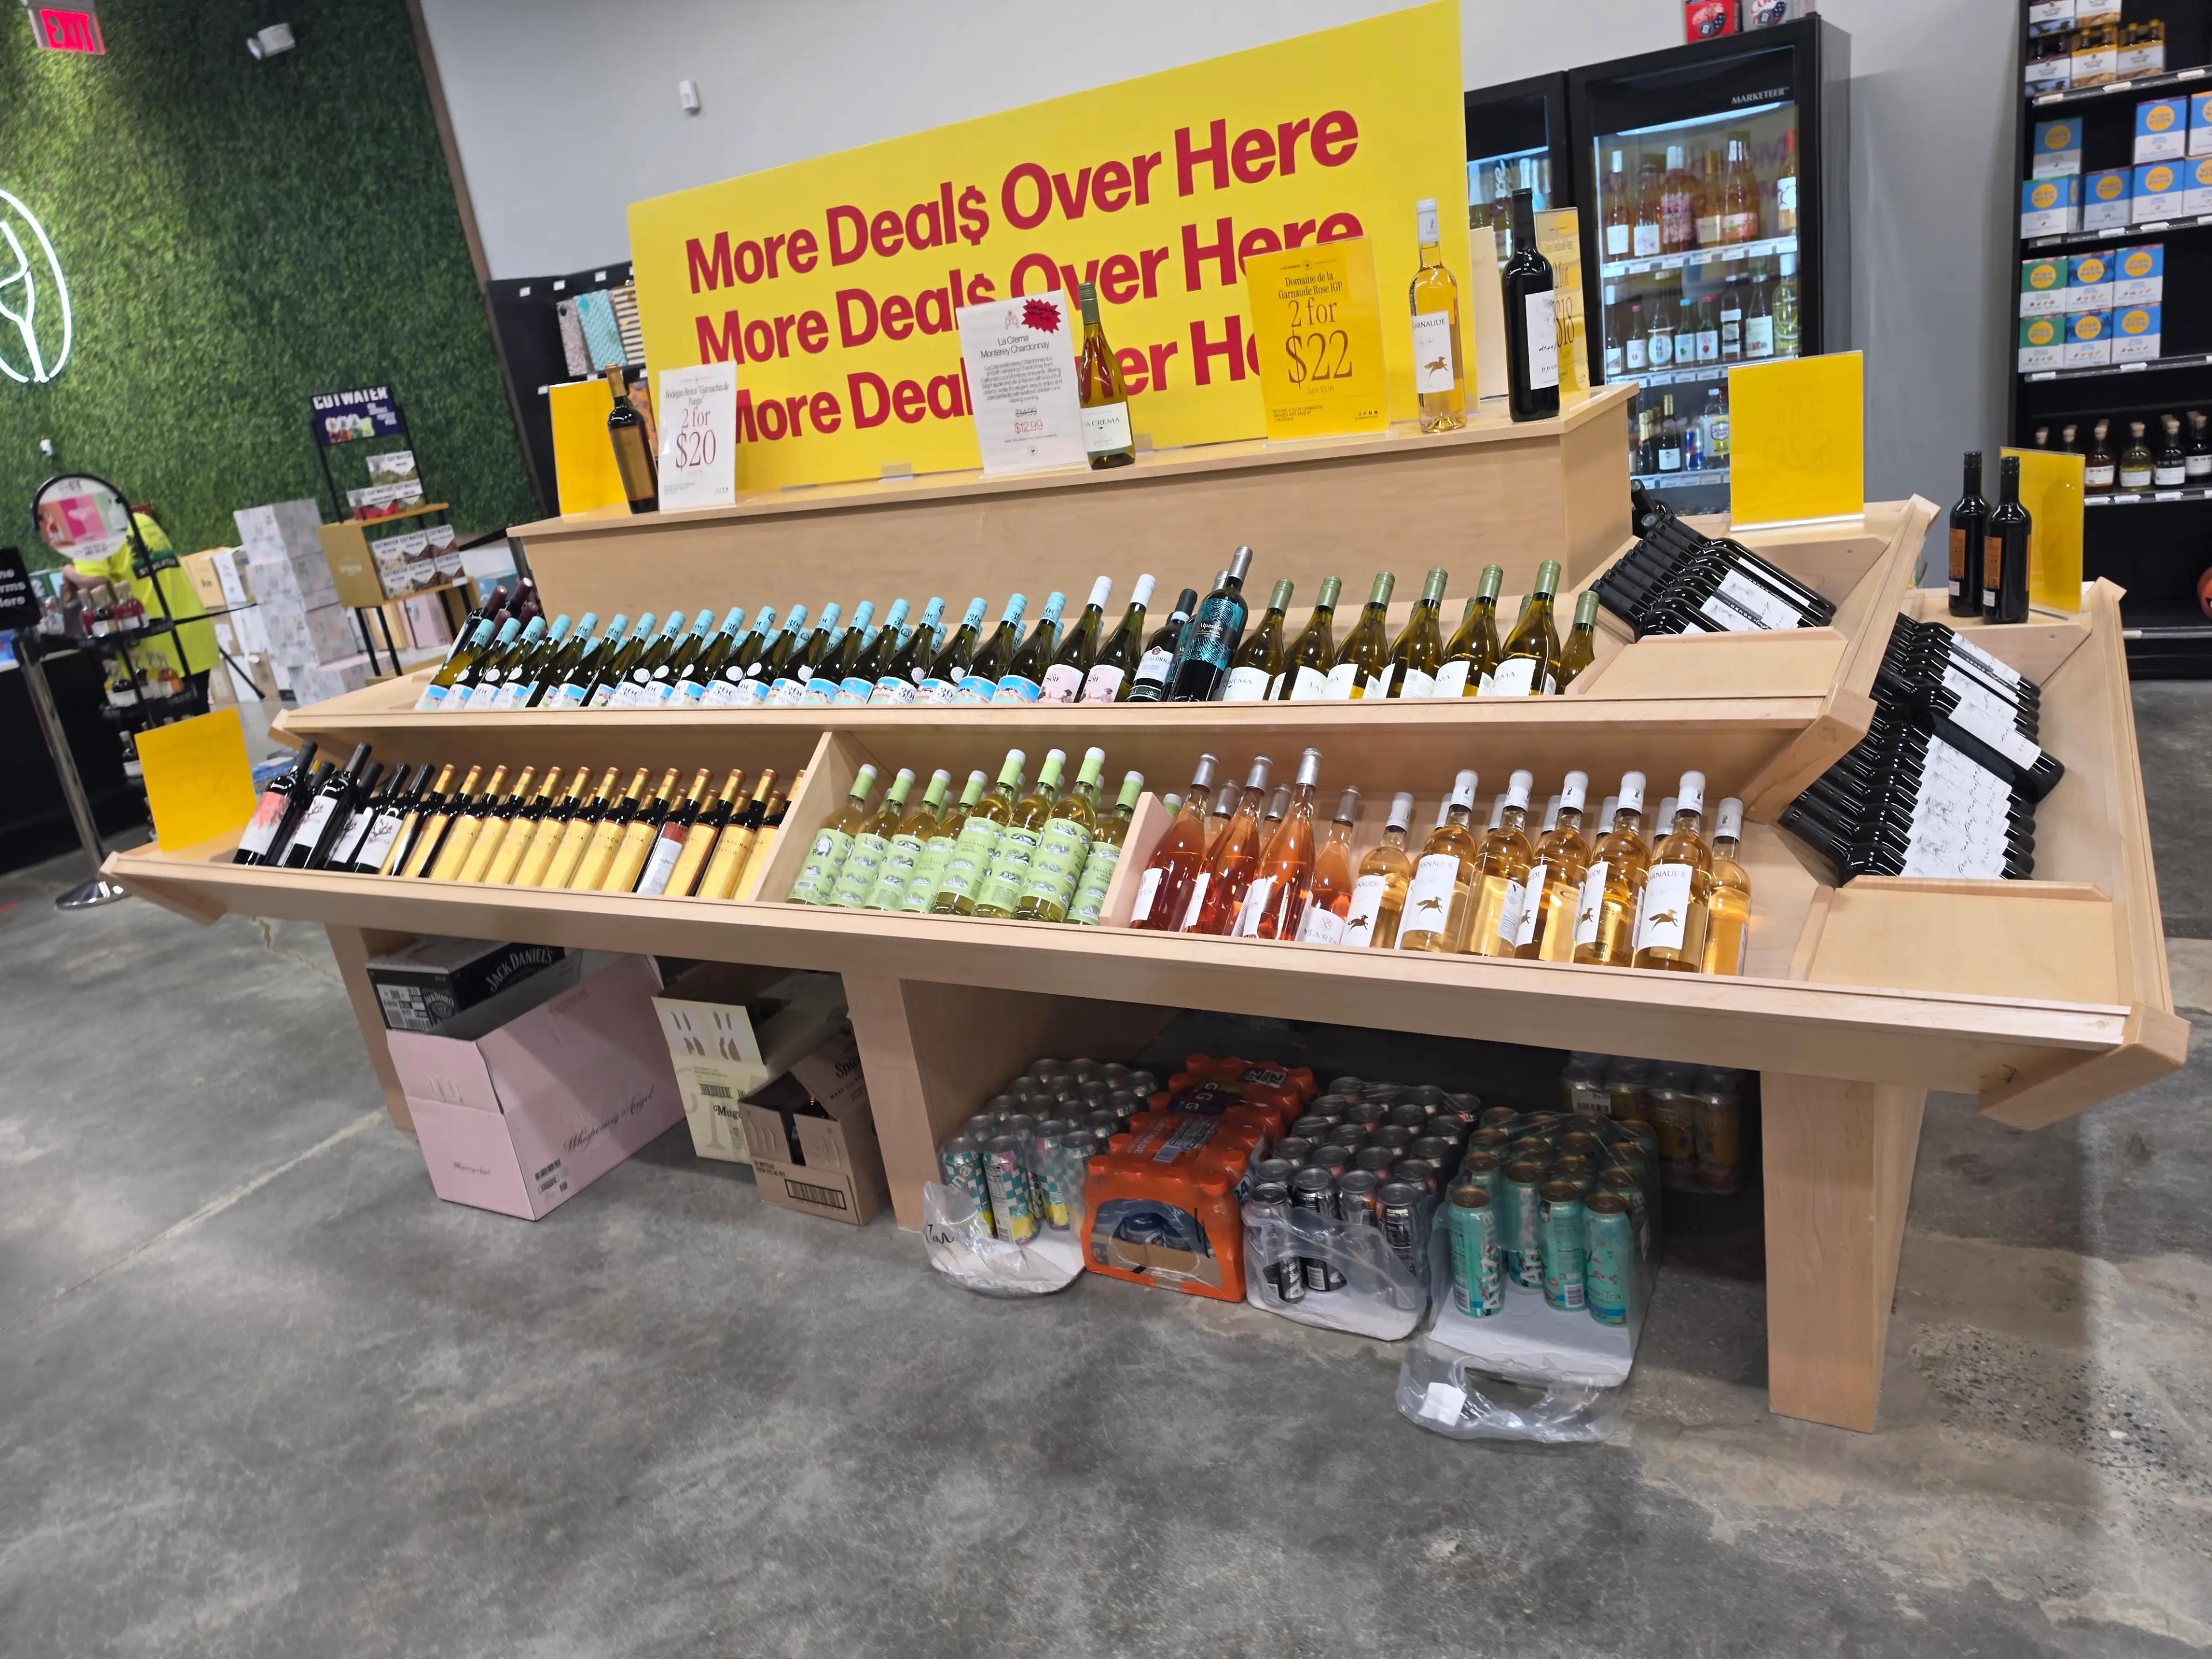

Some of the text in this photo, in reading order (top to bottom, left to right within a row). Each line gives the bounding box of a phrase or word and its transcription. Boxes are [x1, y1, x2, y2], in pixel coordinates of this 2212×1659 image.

[40, 9, 94, 53] EXIT
[1731, 88, 1786, 105] MARKETEER
[686, 229, 818, 294] More
[1001, 151, 1161, 230] Over
[1175, 110, 1358, 198] Here
[1278, 287, 1312, 299] Garnaude
[1330, 281, 1343, 292] IGP
[1285, 271, 1334, 287] Domaine de la
[695, 309, 828, 365] More
[1010, 246, 1168, 310] Over
[1289, 297, 1337, 327] 2 for
[981, 341, 1050, 358] Monterey Chardonnay
[998, 335, 1029, 346] La Crema
[1285, 329, 1353, 390] $22
[312, 385, 389, 410] CUTWATER
[847, 357, 974, 430] Deal
[682, 407, 711, 428] 2 for
[1091, 416, 1120, 427] CREMA
[676, 429, 716, 472] $20
[486, 946, 554, 993] JACK DANIEL'S
[713, 1105, 740, 1120] Mug
